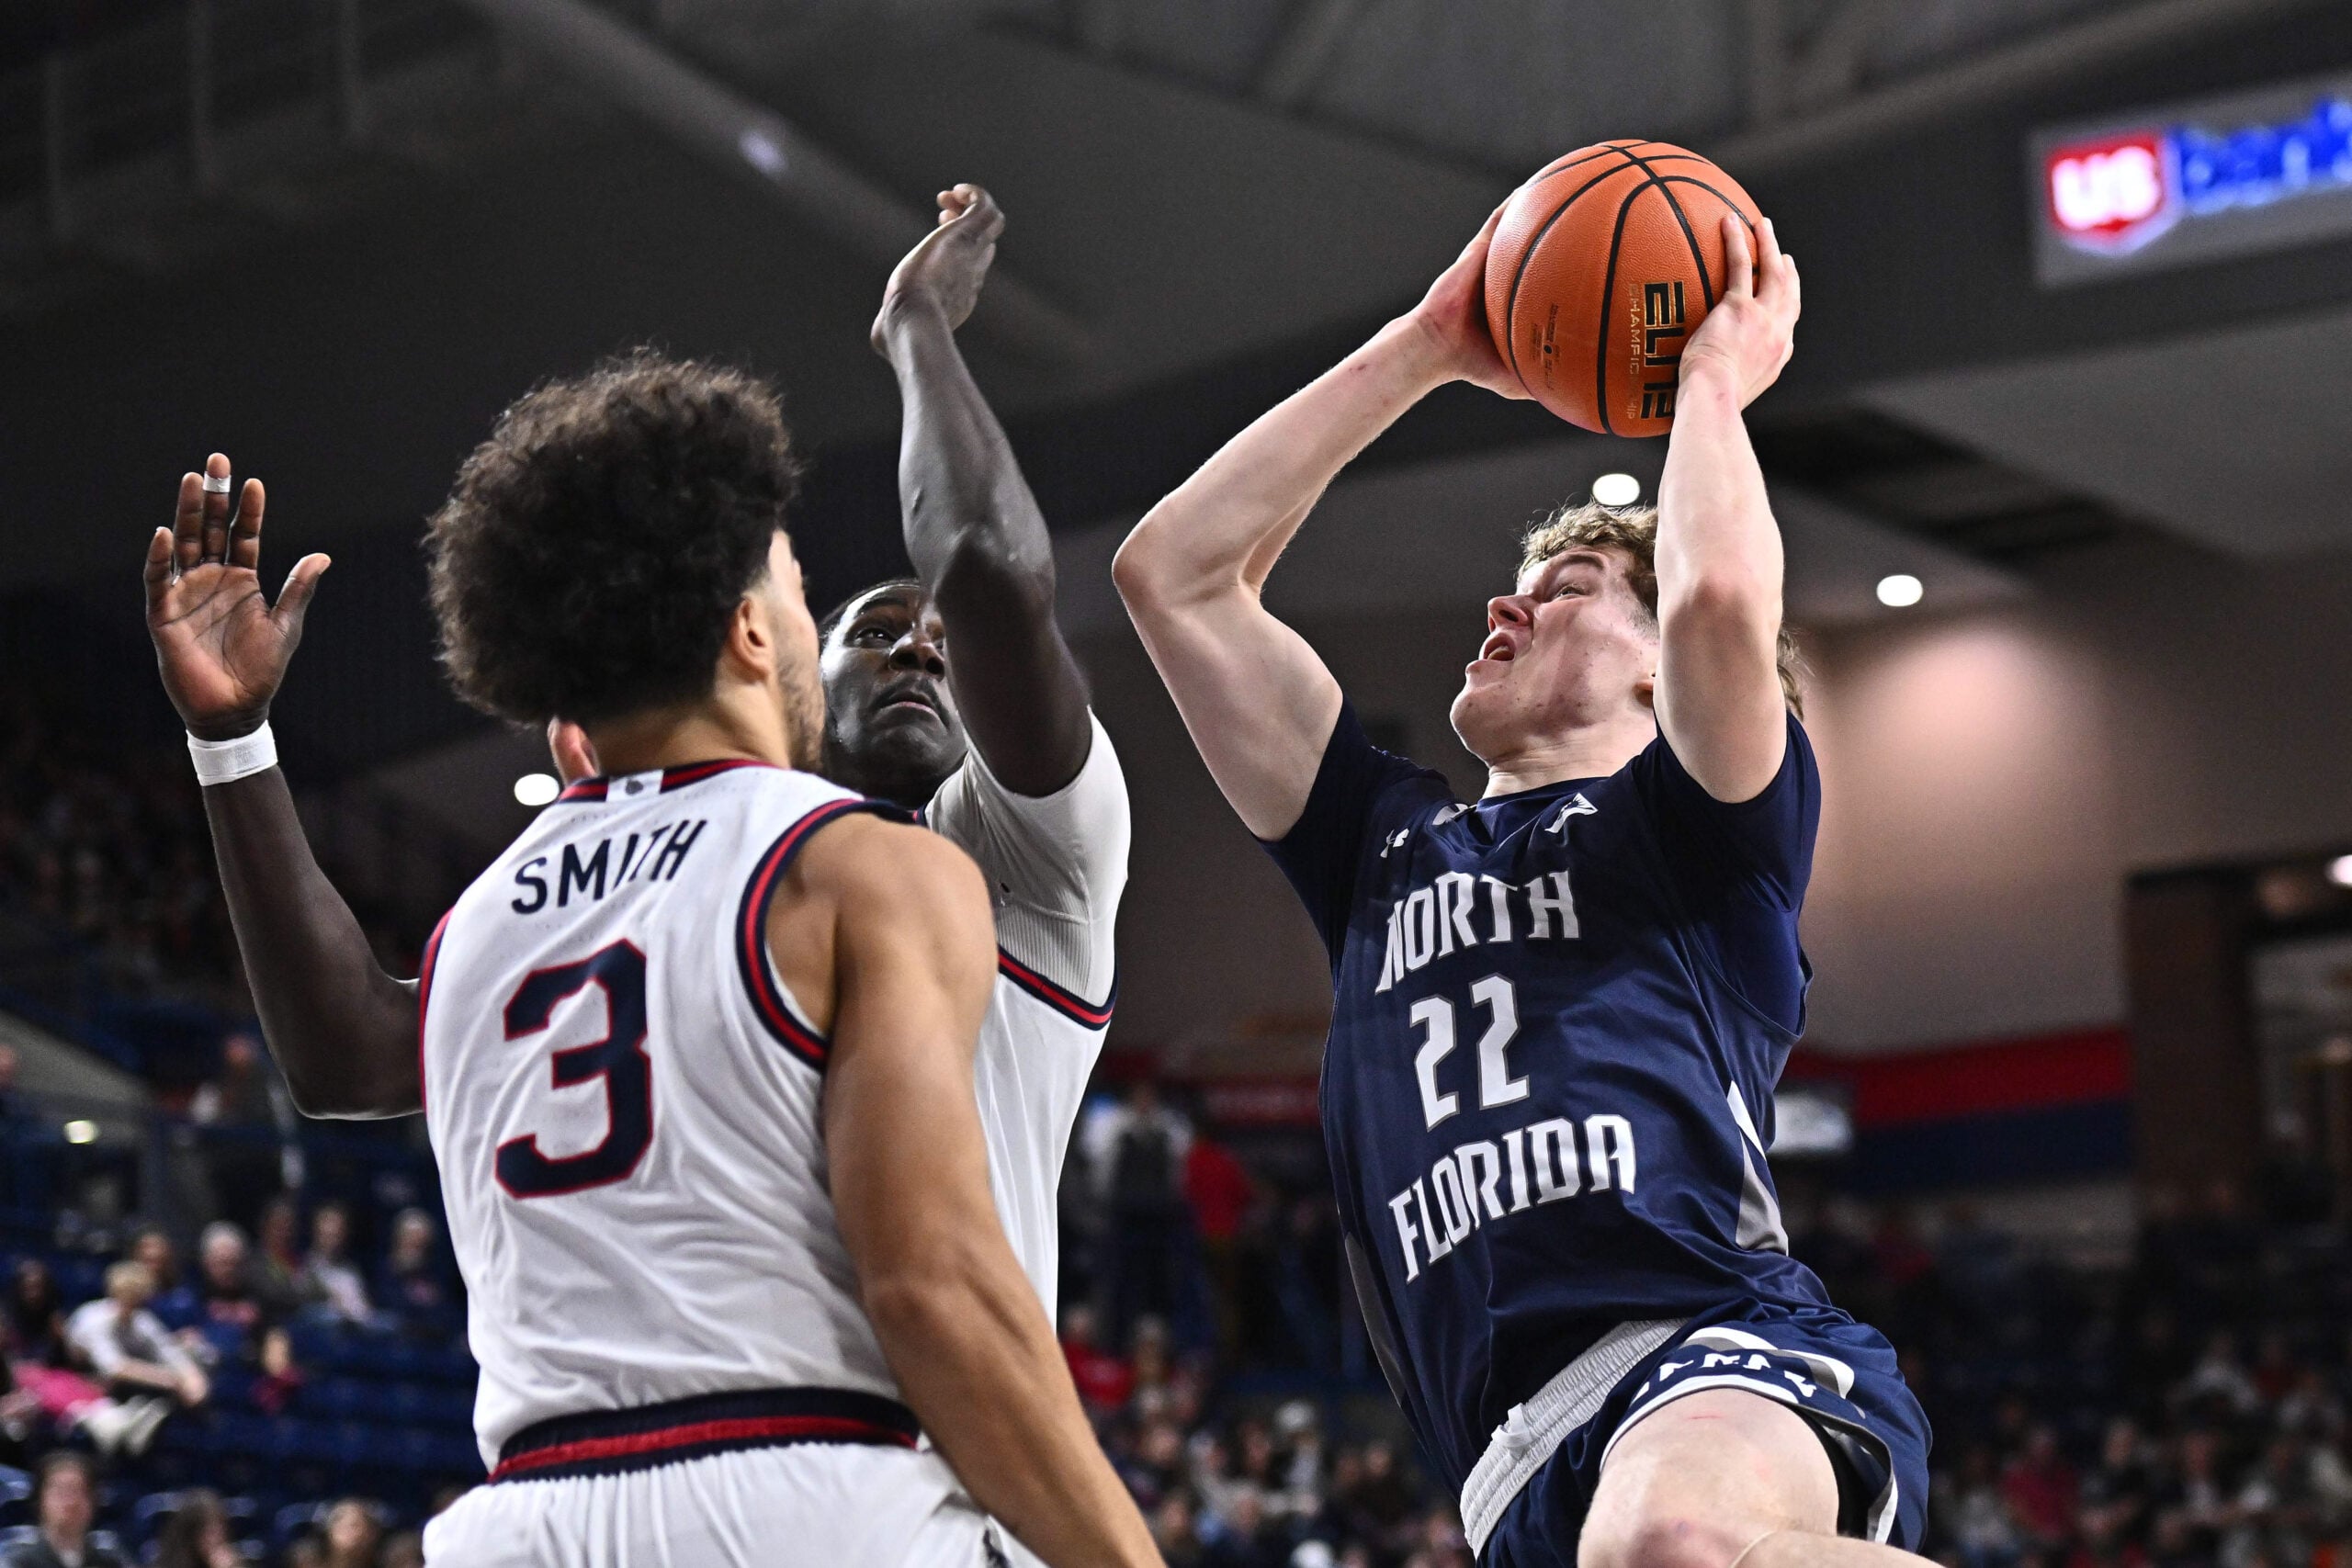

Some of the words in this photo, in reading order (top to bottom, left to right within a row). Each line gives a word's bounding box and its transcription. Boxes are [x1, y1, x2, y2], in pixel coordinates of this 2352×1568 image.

[2051, 143, 2161, 231] US
[511, 819, 707, 915] SMITH
[1375, 866, 1581, 995] NORTH
[494, 938, 654, 1199] 3
[1409, 972, 1531, 1132] 22
[1388, 1113, 1636, 1283] FLORIDA
